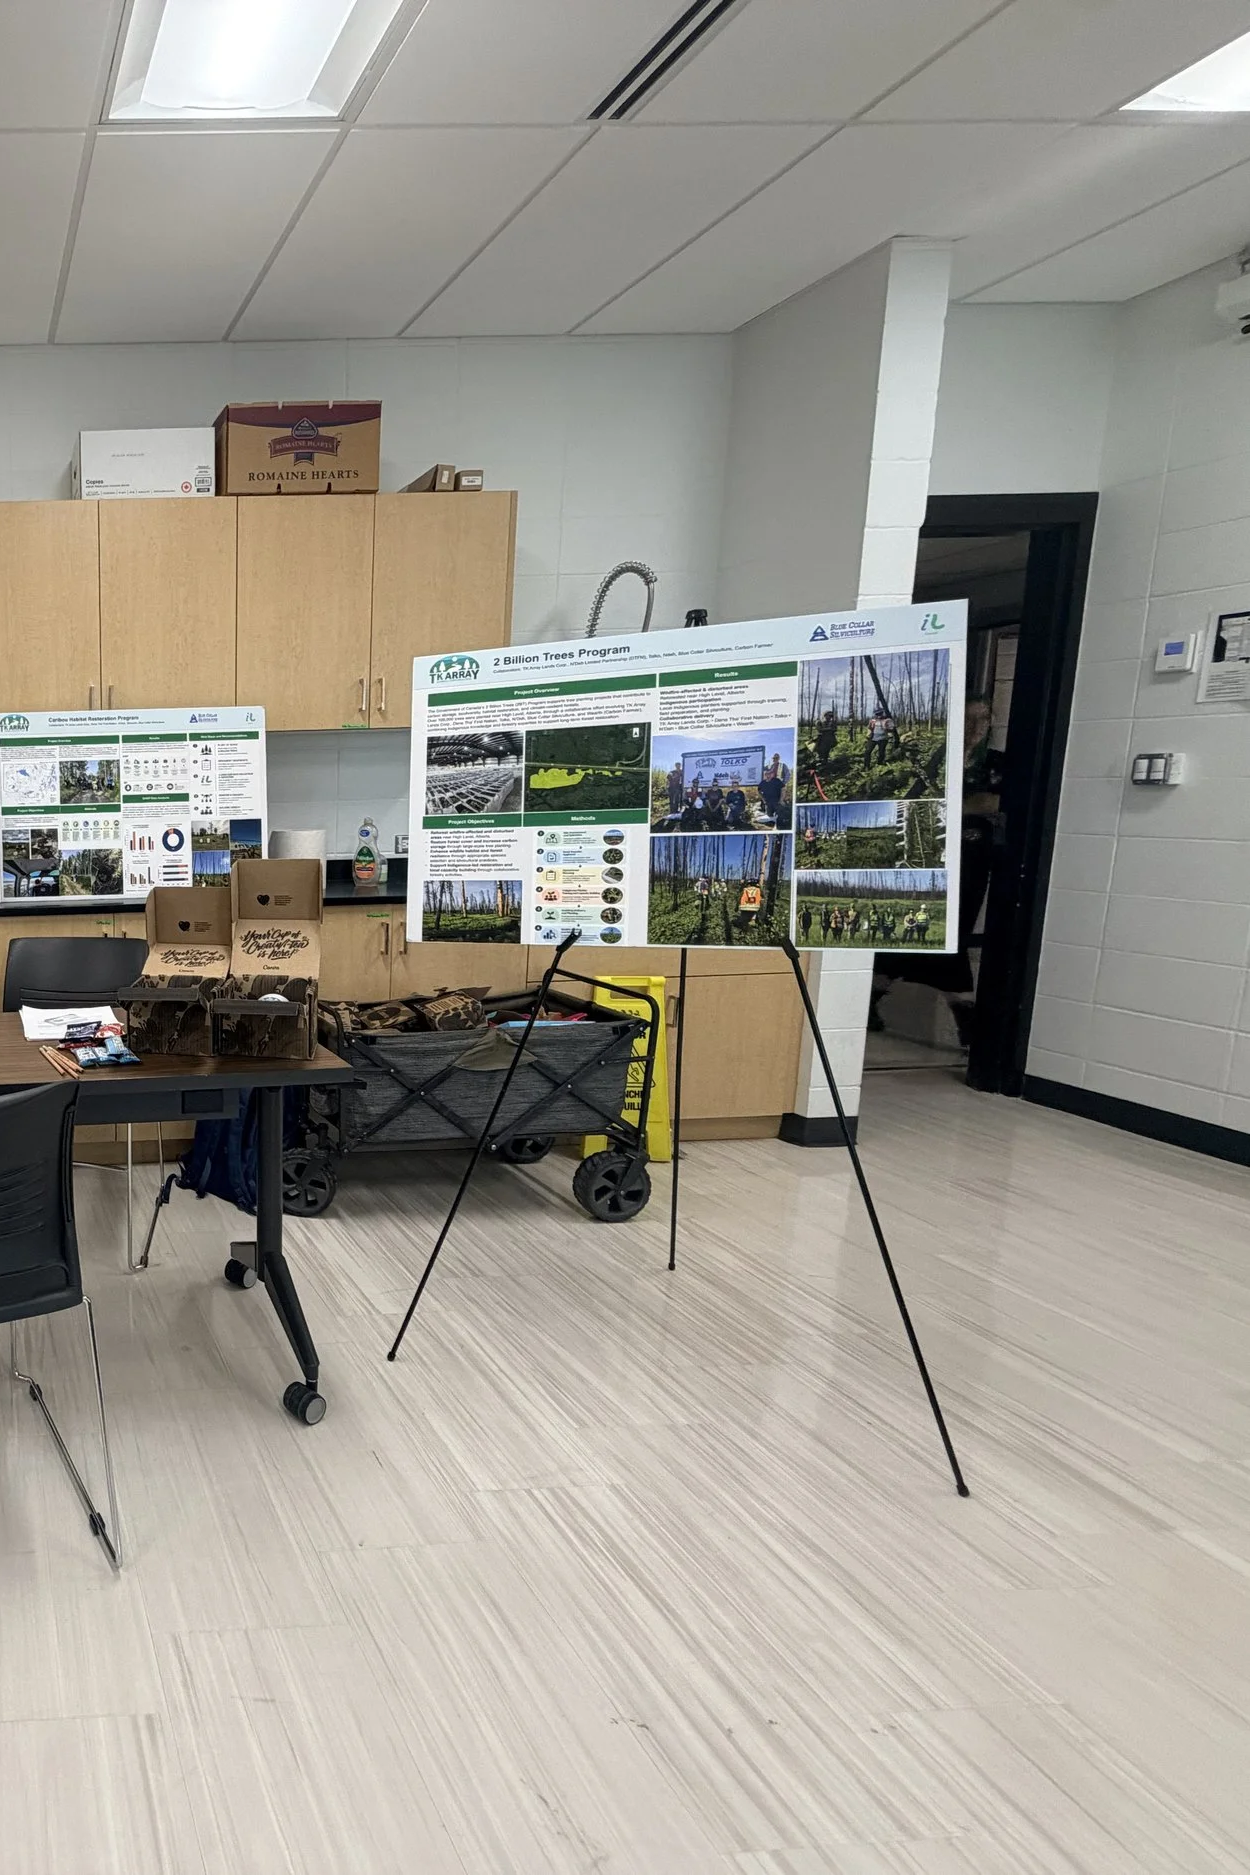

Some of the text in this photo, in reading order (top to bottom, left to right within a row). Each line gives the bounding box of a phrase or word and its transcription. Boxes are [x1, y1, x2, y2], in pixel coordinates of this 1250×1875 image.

[248, 469, 359, 481] ROMAINE HEARTS
[848, 620, 875, 629] COLLAR
[493, 646, 630, 666] 2 Billion Trees Program
[429, 669, 480, 684] TK ARRAY
[714, 671, 739, 679] Results
[721, 757, 748, 765] TOLKO
[271, 929, 292, 941] Cup
[268, 949, 296, 961] here!
